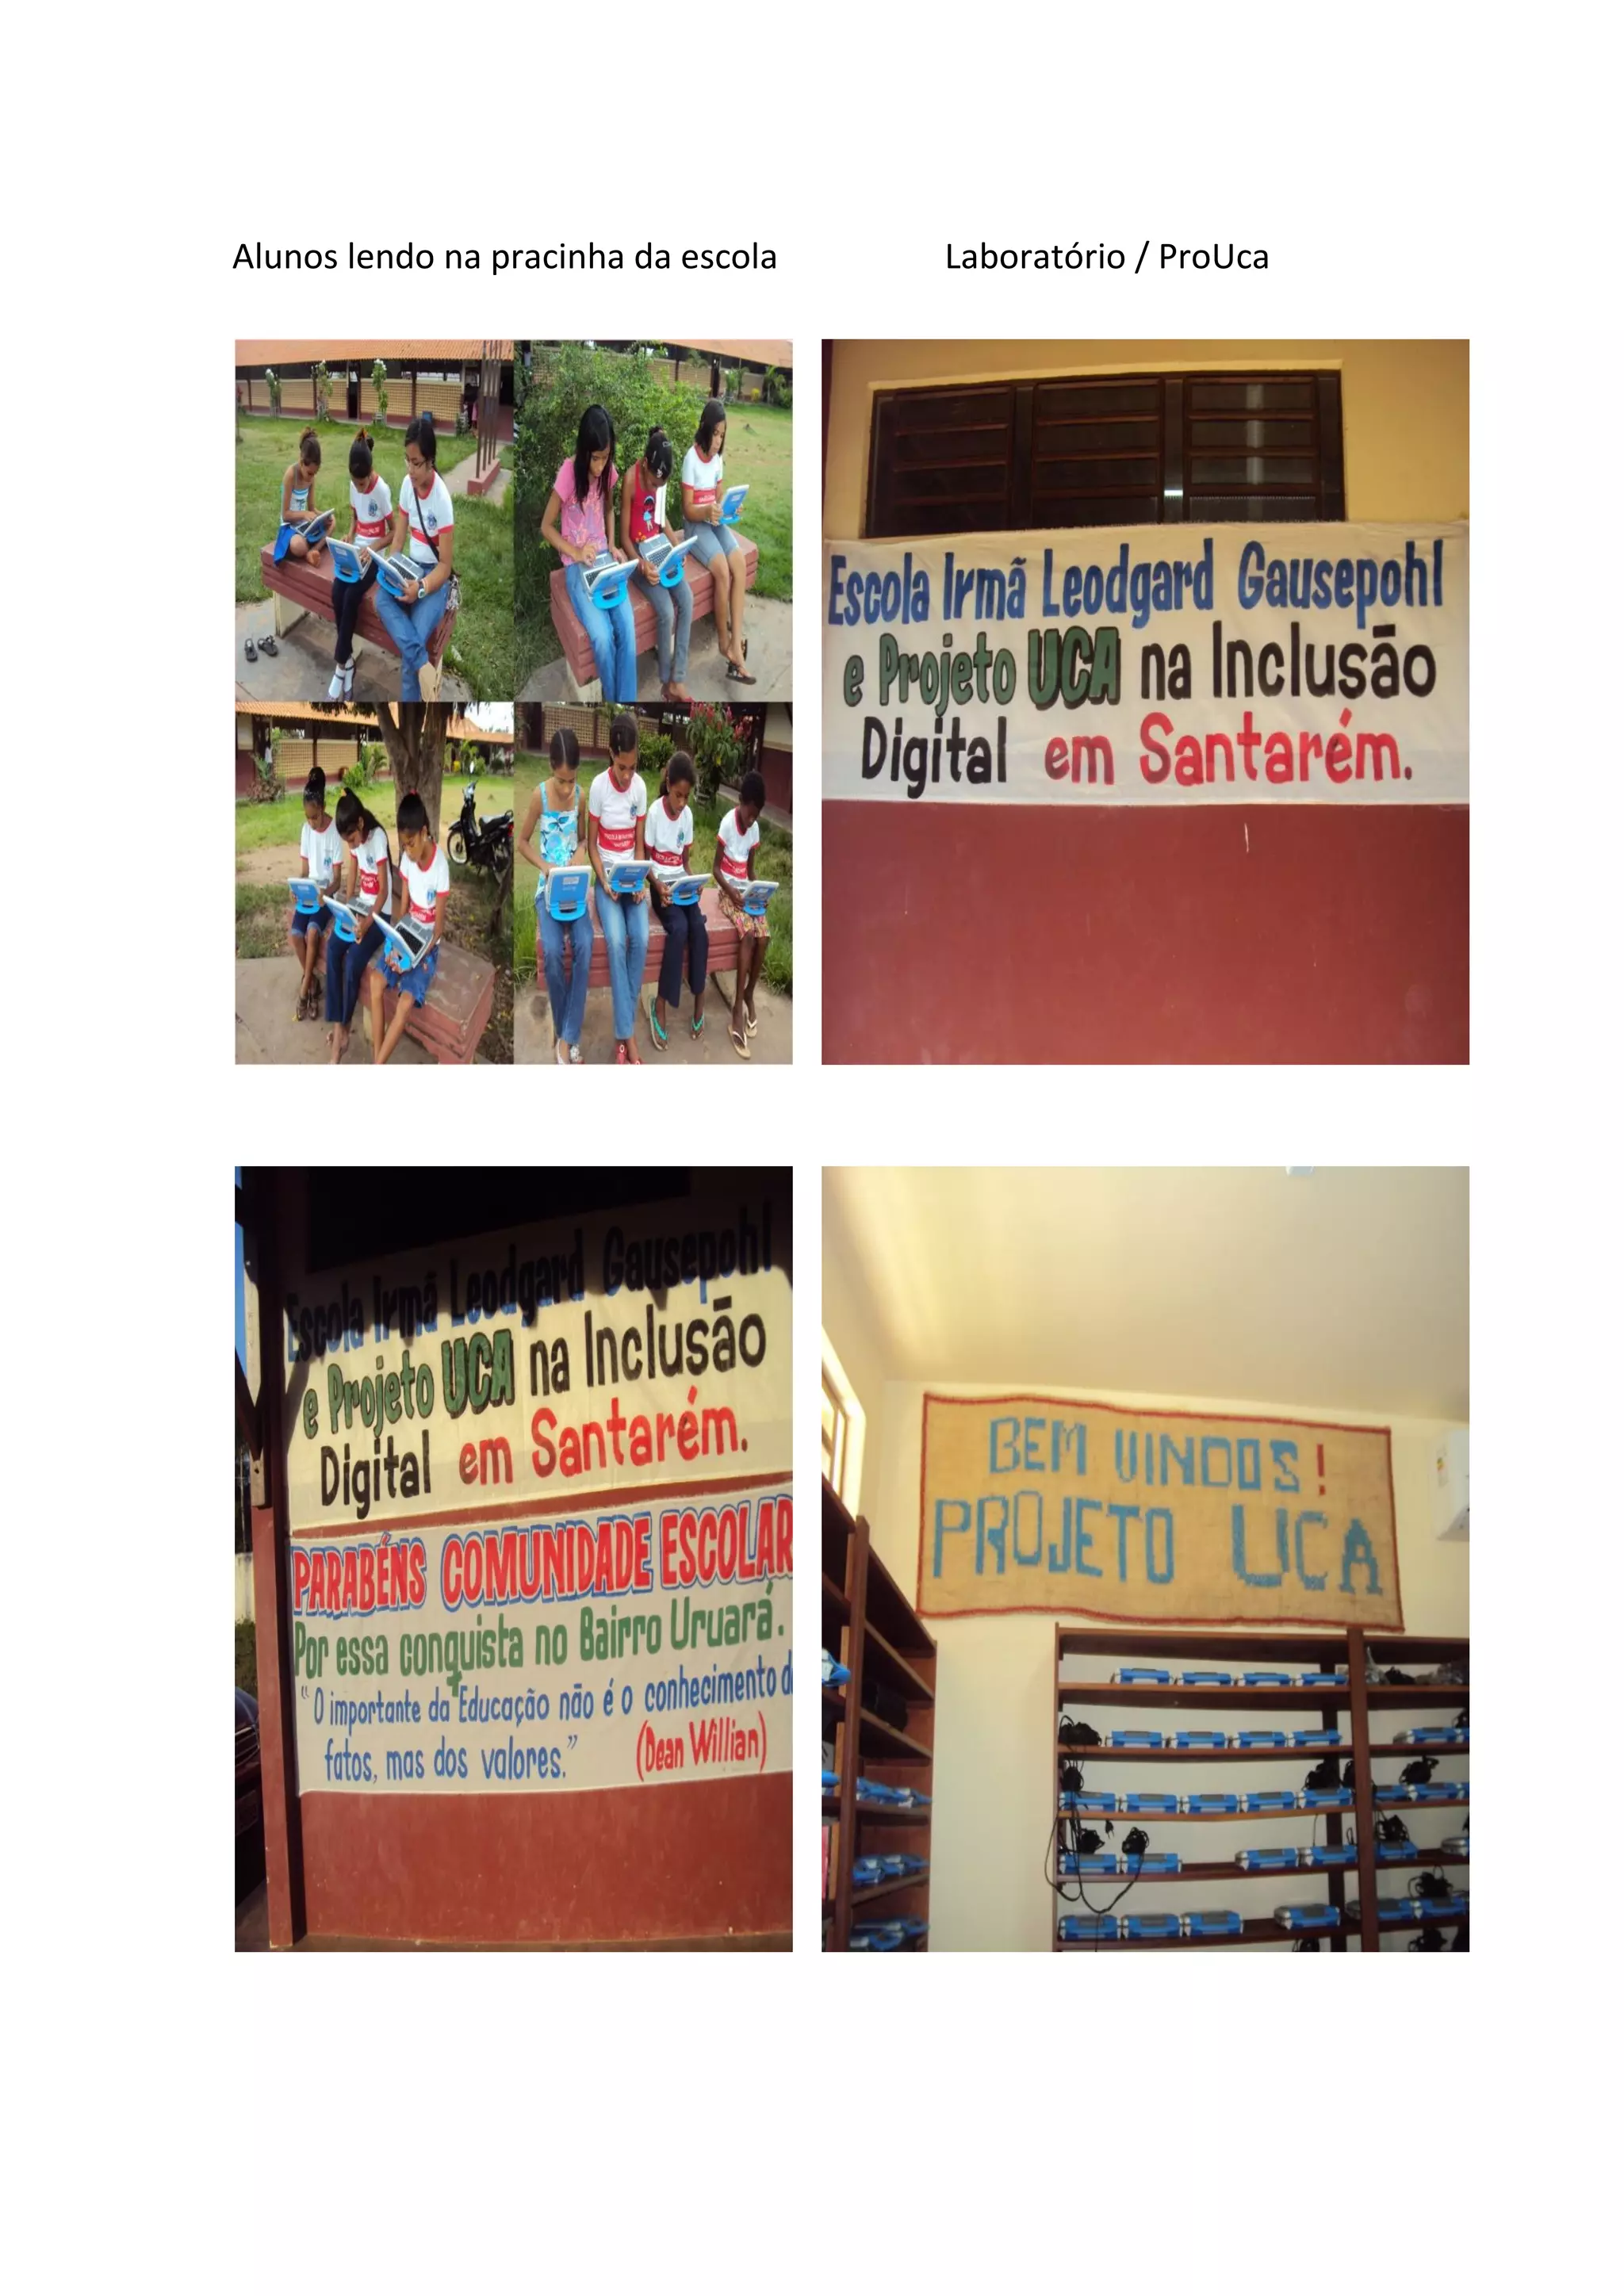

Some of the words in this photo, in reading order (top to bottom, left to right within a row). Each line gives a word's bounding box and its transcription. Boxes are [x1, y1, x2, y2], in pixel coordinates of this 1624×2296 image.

[233, 241, 338, 270] Alunos
[349, 241, 434, 270] lendo
[446, 249, 480, 270] na
[492, 241, 623, 276] pracinha
[634, 242, 670, 270] da
[681, 241, 776, 270] escola
[947, 241, 1125, 270] Laboratório
[1134, 240, 1150, 274] /
[1160, 243, 1268, 270] ProUca
[828, 553, 930, 626] Escola
[943, 553, 1027, 620] Irmã
[1043, 538, 1213, 629] Leodgard
[1238, 539, 1443, 629] Gausepohl
[844, 655, 864, 707] e
[879, 632, 1017, 717] Projeto
[1028, 626, 1120, 710] UCA
[1141, 642, 1191, 700] na
[1212, 620, 1436, 699] Inclusão
[862, 716, 1007, 799] Digital
[1044, 736, 1114, 785] em
[1139, 708, 1412, 786] Santarém.
[287, 1280, 365, 1363] Escola
[450, 1229, 584, 1328] Leodgard
[603, 1201, 773, 1304] Gausepohl
[303, 1388, 319, 1439] e
[327, 1349, 435, 1437] Projeto
[441, 1329, 515, 1419] UCA
[530, 1337, 570, 1396] na
[584, 1295, 766, 1387] Inclusão
[320, 1429, 431, 1520] Digital
[459, 1436, 513, 1486] em
[531, 1385, 748, 1478] Santarém.
[990, 1416, 1086, 1475] BEM
[292, 1531, 427, 1620] PARABÉNS
[441, 1511, 653, 1613] COMUNIDADE
[660, 1494, 793, 1590] ESCOLAR
[933, 1490, 1174, 1584] PROJETO
[1231, 1503, 1384, 1594] UCA
[295, 1621, 328, 1679] Por
[336, 1634, 389, 1676] essa
[400, 1613, 523, 1697] conquista
[536, 1624, 568, 1666] no
[580, 1605, 661, 1662] Bairro
[671, 1579, 784, 1651] Uruará.
[330, 1689, 422, 1736] importante
[429, 1686, 450, 1722] da
[459, 1685, 550, 1728] Educação
[559, 1683, 594, 1720] não
[603, 1678, 614, 1716] é
[622, 1686, 634, 1715] o
[645, 1655, 777, 1712] conhecimento
[324, 1738, 377, 1784] fatos,
[386, 1750, 425, 1780] mas
[434, 1735, 469, 1778] dos
[637, 1720, 684, 1782] (Dean
[689, 1711, 768, 1774] Willian)
